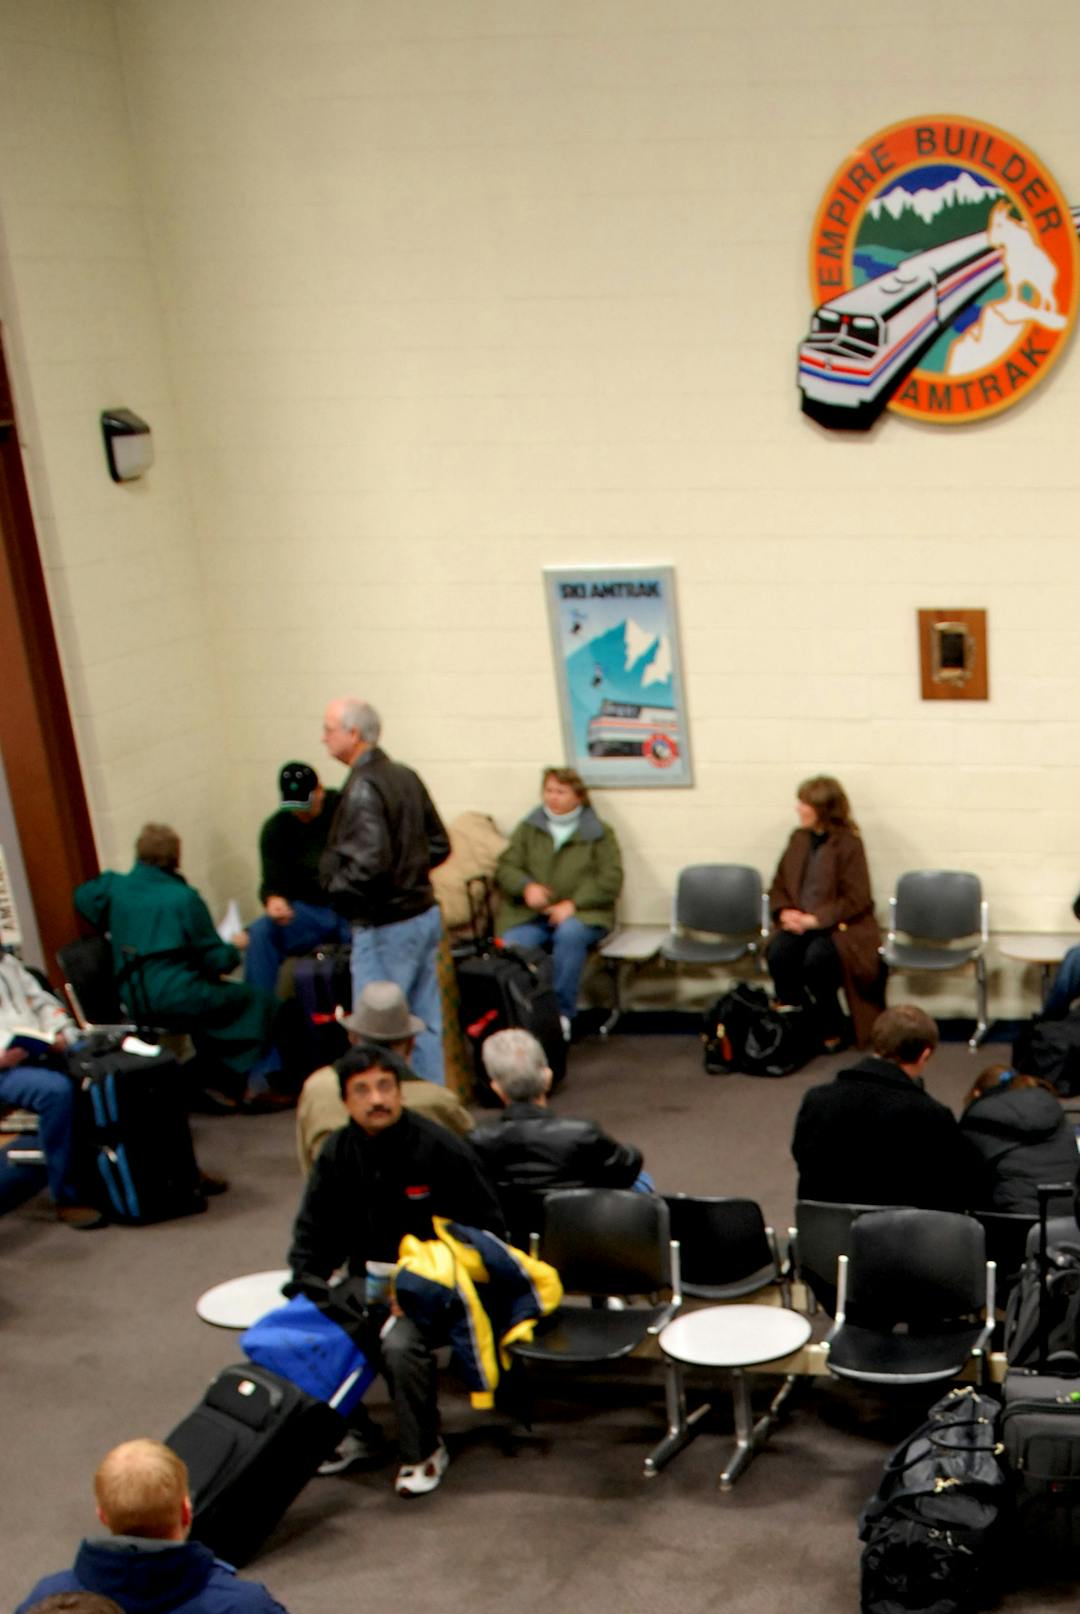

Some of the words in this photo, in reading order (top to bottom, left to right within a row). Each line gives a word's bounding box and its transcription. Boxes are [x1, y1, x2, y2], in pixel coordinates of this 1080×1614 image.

[820, 142, 896, 287] EMPIRE
[915, 127, 1064, 233] BUILDER
[902, 345, 1049, 411] AMTRAK
[559, 583, 586, 599] SKI
[591, 580, 661, 598] AMTRAK
